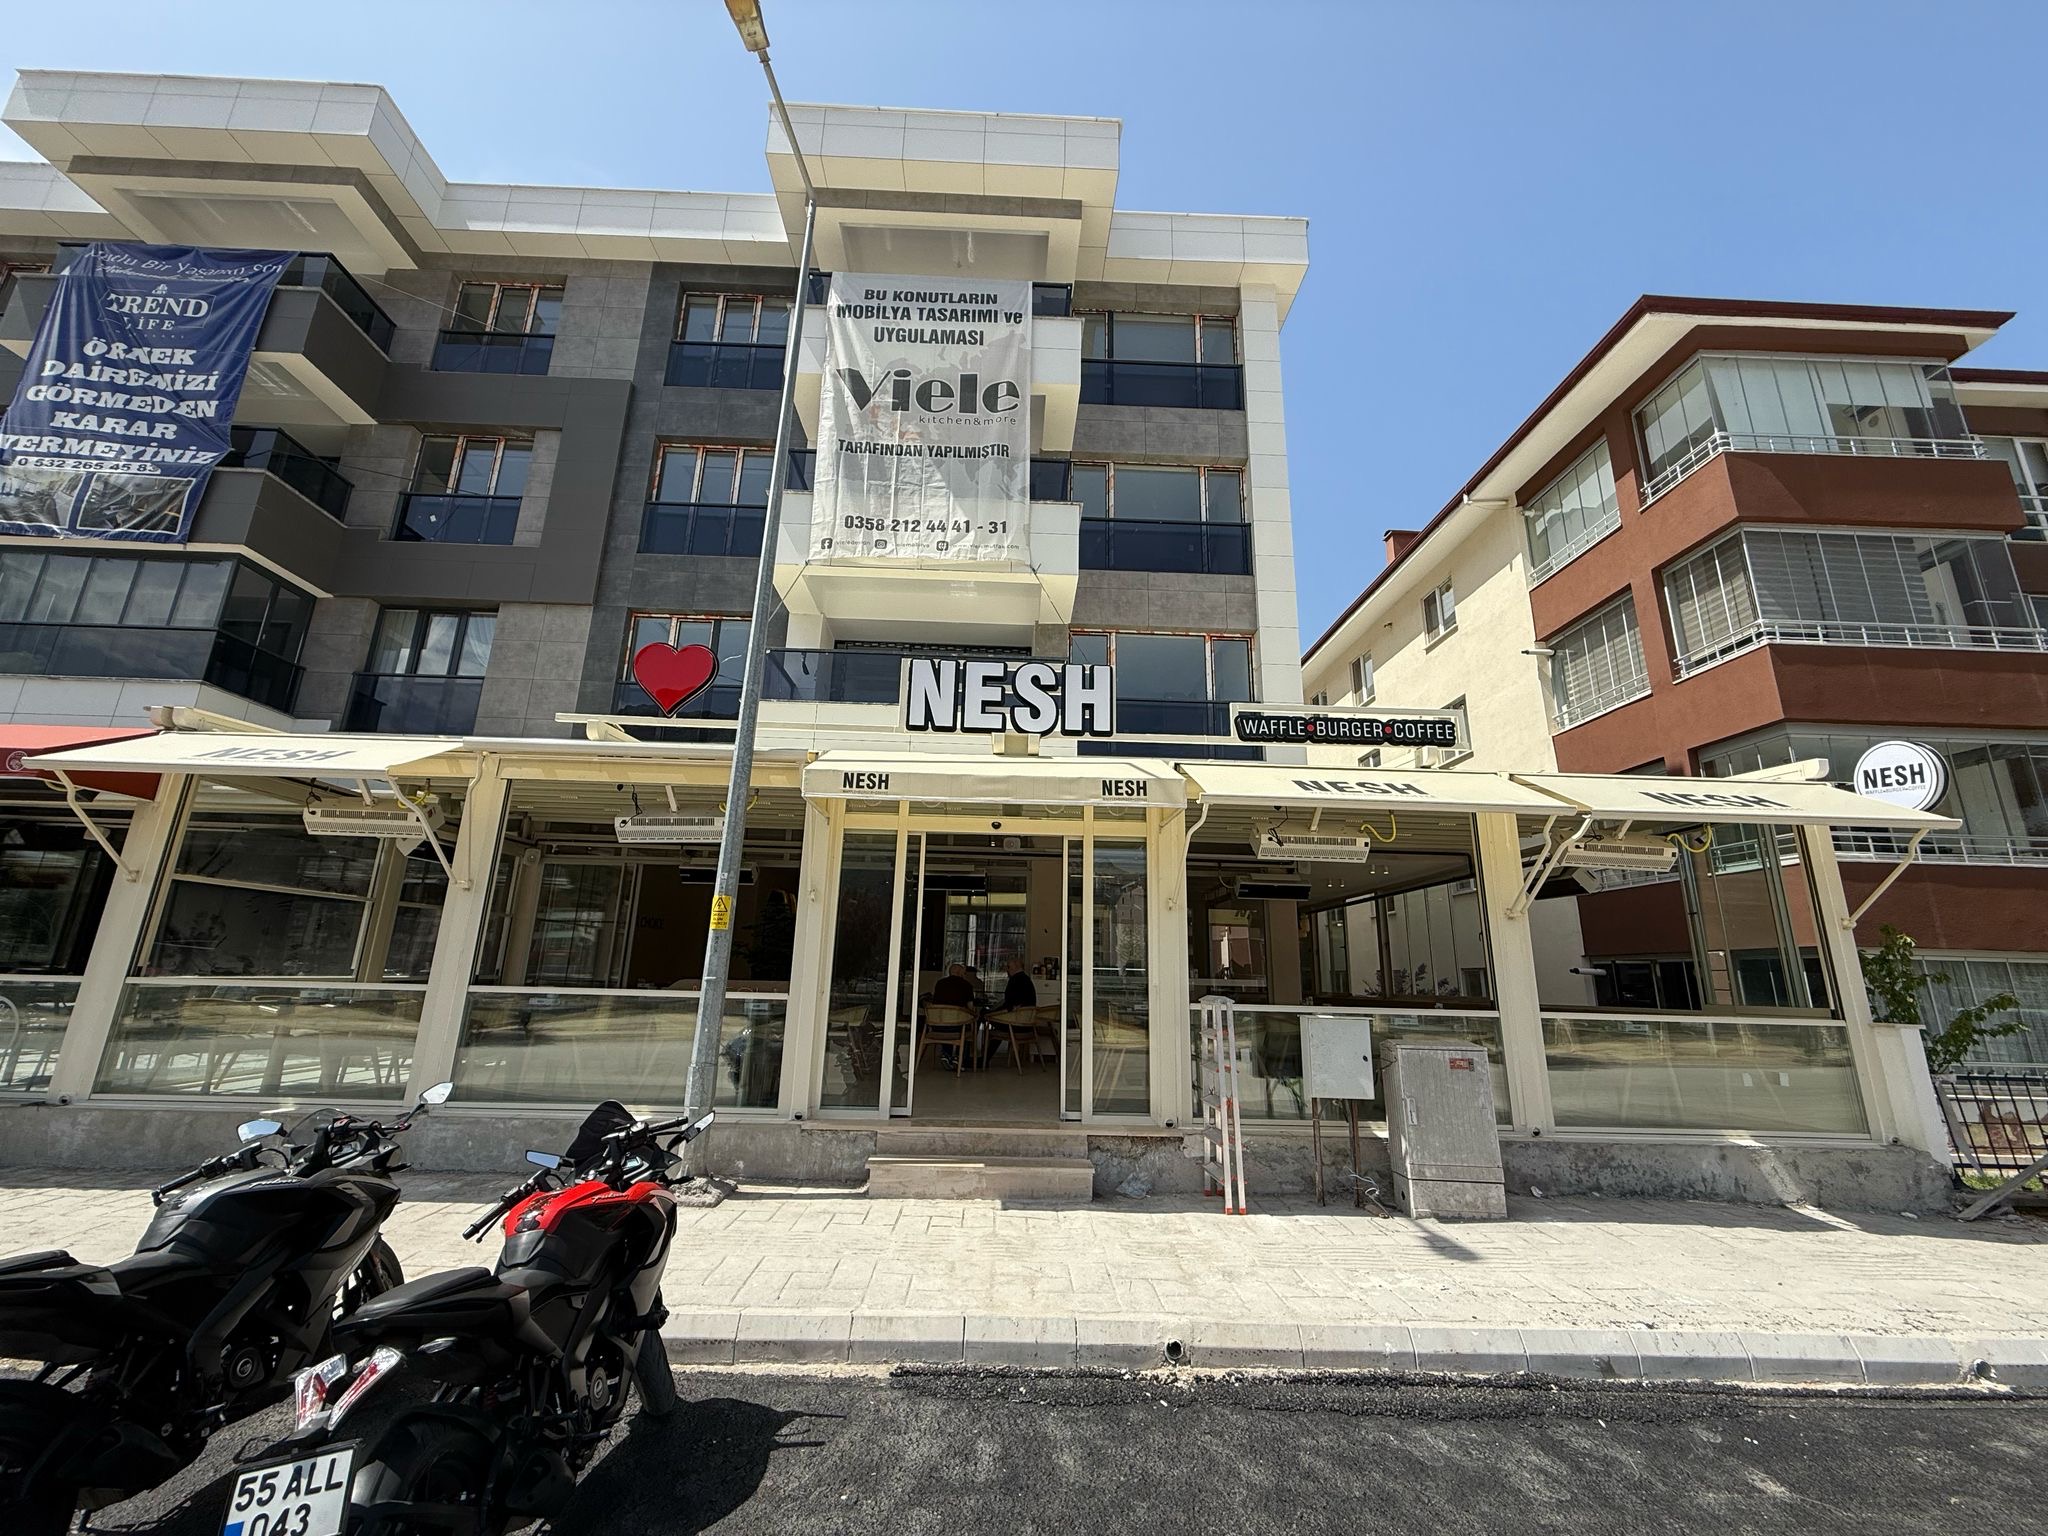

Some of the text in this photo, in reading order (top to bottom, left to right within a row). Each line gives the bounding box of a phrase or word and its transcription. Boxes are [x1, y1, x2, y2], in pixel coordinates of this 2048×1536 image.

[105, 293, 209, 318] TREND
[864, 289, 998, 305] BU KONUTLARIN
[837, 303, 1023, 324] MOBİLYA TASARIMI ve
[874, 327, 984, 346] UYGULAMASI
[83, 337, 198, 365] ÖRNEK
[41, 360, 219, 392] DAİREMİZİ
[26, 382, 219, 418] GÖRMEDEN
[836, 368, 1020, 414] Viele
[49, 411, 178, 440] KARAR
[919, 415, 1017, 426] kitchen&more
[0, 434, 220, 464] VERMEYİNİZ
[838, 439, 1010, 459] TARAFINDAN YAPILMIŞTIR
[18, 458, 28, 466] 0
[34, 458, 66, 468] 532
[71, 460, 104, 470] 265
[109, 463, 131, 472] 45
[845, 515, 885, 531] 0358
[891, 519, 920, 532] 212
[926, 520, 947, 533] 44
[952, 520, 970, 533] 41
[989, 521, 1007, 534] 31
[906, 659, 1115, 737] NESH
[1243, 719, 1455, 740] WAFFLE BURGER COFFEE
[192, 747, 357, 762] NESH
[843, 772, 890, 790] NESH
[1863, 763, 1925, 789] NESH
[1102, 779, 1147, 797] NESH
[1291, 780, 1429, 795] NESH
[1638, 791, 1792, 808] NESH
[235, 1458, 343, 1512] 55 ALL
[248, 1503, 311, 1536] 043
